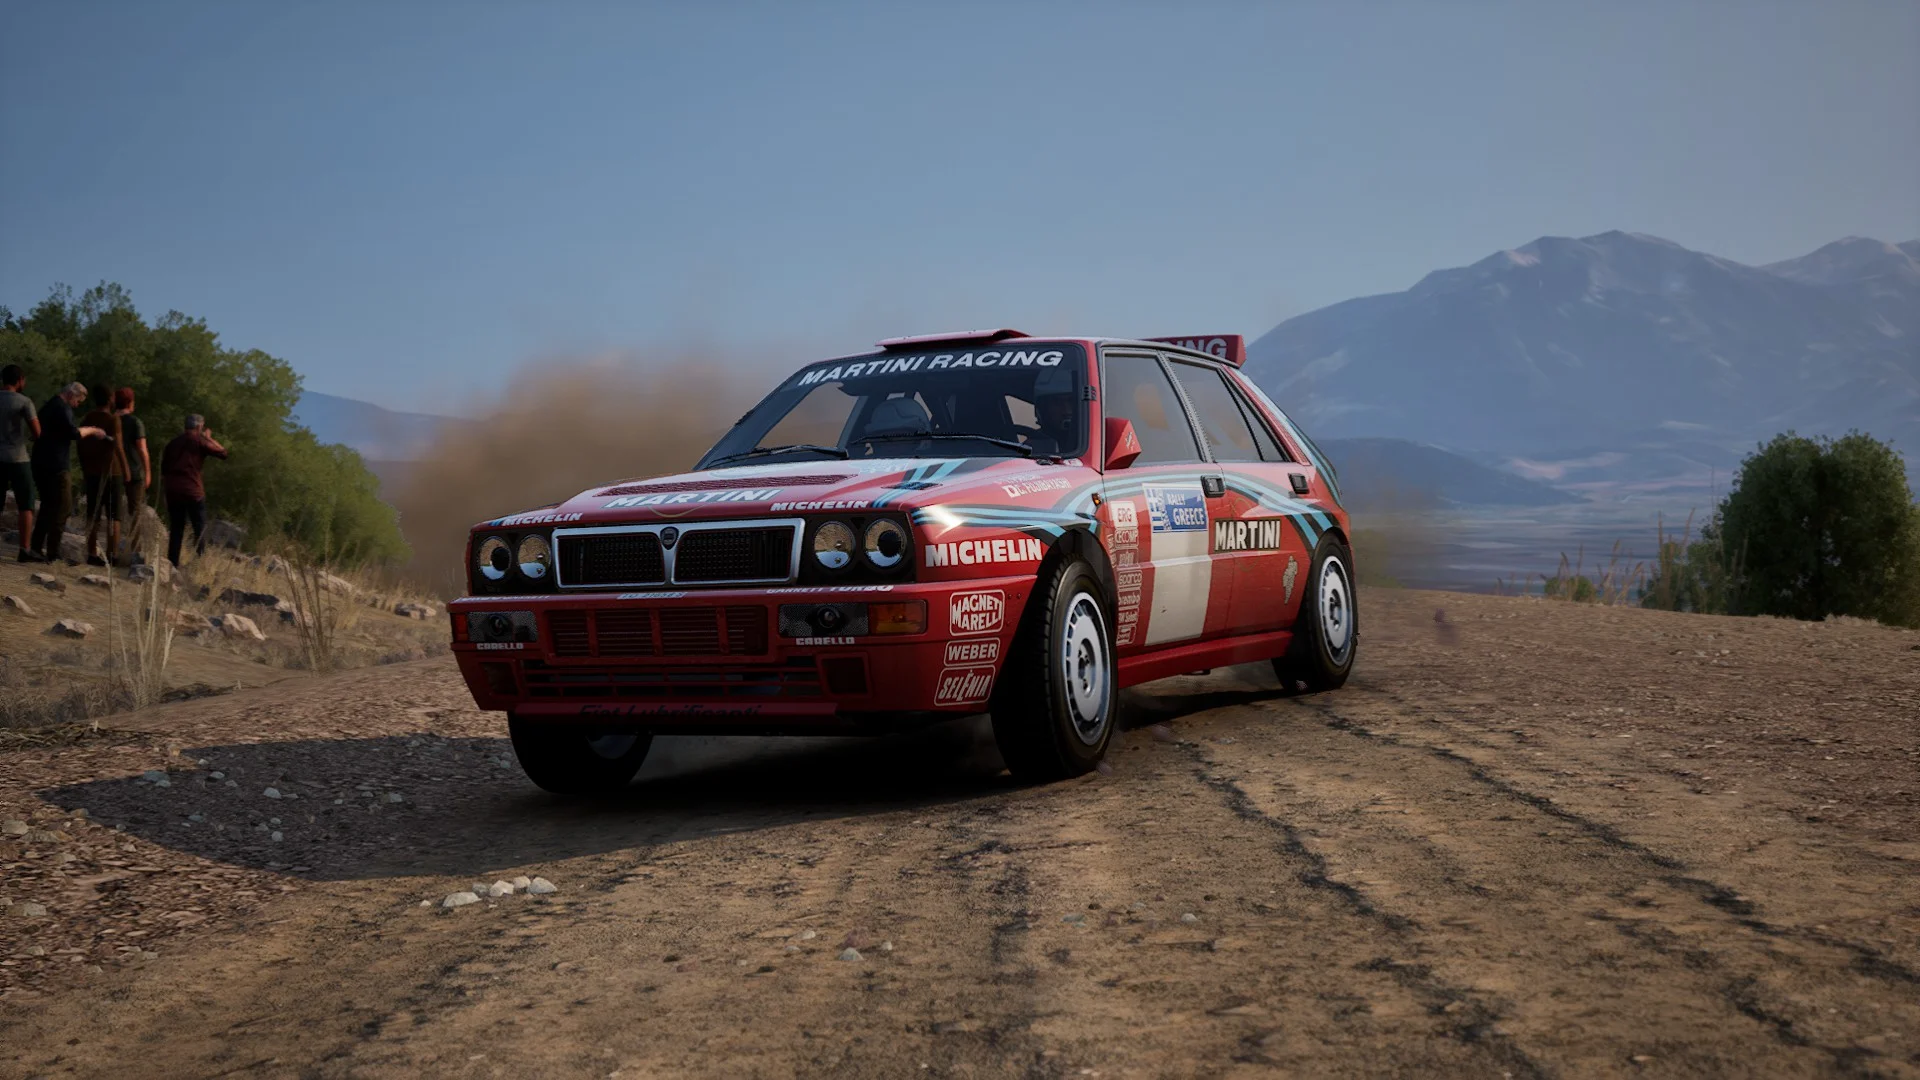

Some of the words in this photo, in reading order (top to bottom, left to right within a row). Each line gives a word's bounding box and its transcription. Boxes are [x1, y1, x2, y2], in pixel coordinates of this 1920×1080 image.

[798, 356, 925, 386] MARTINI
[927, 351, 1064, 370] RACING
[605, 490, 785, 508] MARTINI
[770, 500, 869, 511] MICHELIN
[501, 512, 584, 526] MICHELIN
[1117, 508, 1132, 522] ERG
[1172, 507, 1205, 526] GREECE
[1215, 520, 1280, 551] MARTINI
[925, 538, 1043, 567] MICHELIN
[476, 641, 524, 650] CARELLO
[795, 636, 855, 646] CARELLO
[948, 643, 998, 661] WEBER
